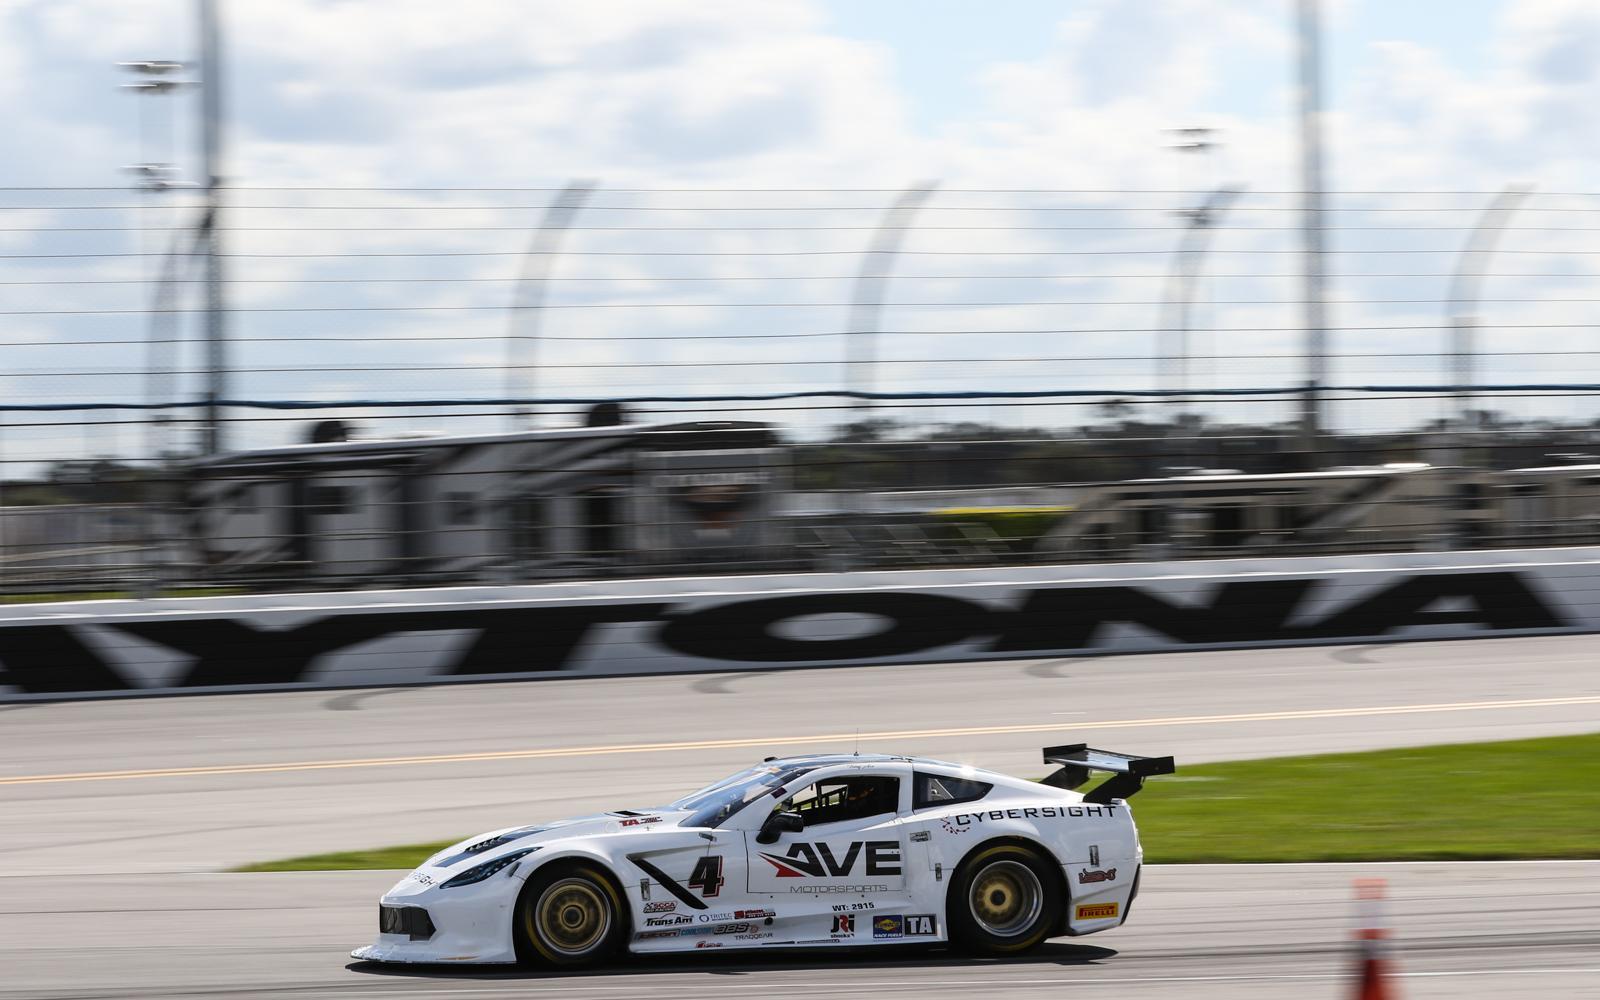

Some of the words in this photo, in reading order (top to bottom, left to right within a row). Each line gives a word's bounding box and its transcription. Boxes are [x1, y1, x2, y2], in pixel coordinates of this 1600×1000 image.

[955, 805, 1117, 827] CYBERSIGHT
[619, 819, 640, 827] TA
[757, 840, 902, 878] AVE
[687, 855, 724, 898] 4
[790, 884, 888, 894] MOTORSPORTS
[851, 901, 875, 910] 2915
[1079, 905, 1115, 917] PIRELLI
[644, 917, 673, 926] Trans
[674, 916, 693, 925] Am
[906, 916, 933, 934] TA
